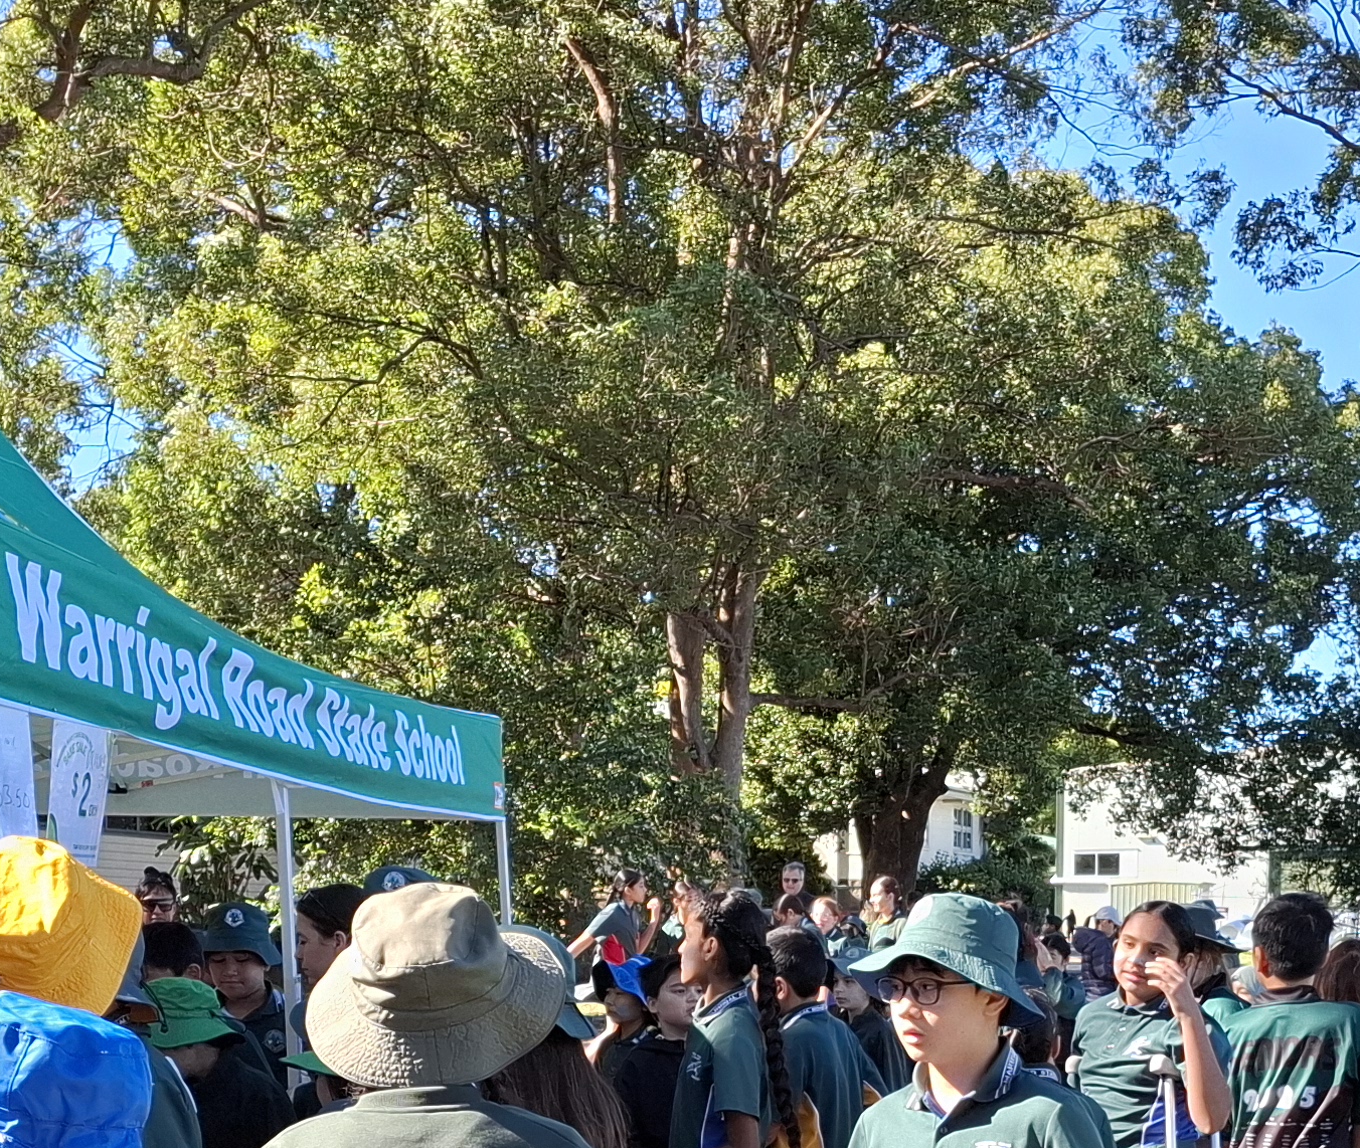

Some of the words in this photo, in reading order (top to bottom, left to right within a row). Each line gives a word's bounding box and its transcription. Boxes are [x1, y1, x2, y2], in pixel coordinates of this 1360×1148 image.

[4, 551, 218, 730] Warrigal
[221, 647, 314, 750] Road
[316, 685, 391, 771] State
[394, 709, 466, 785] School
